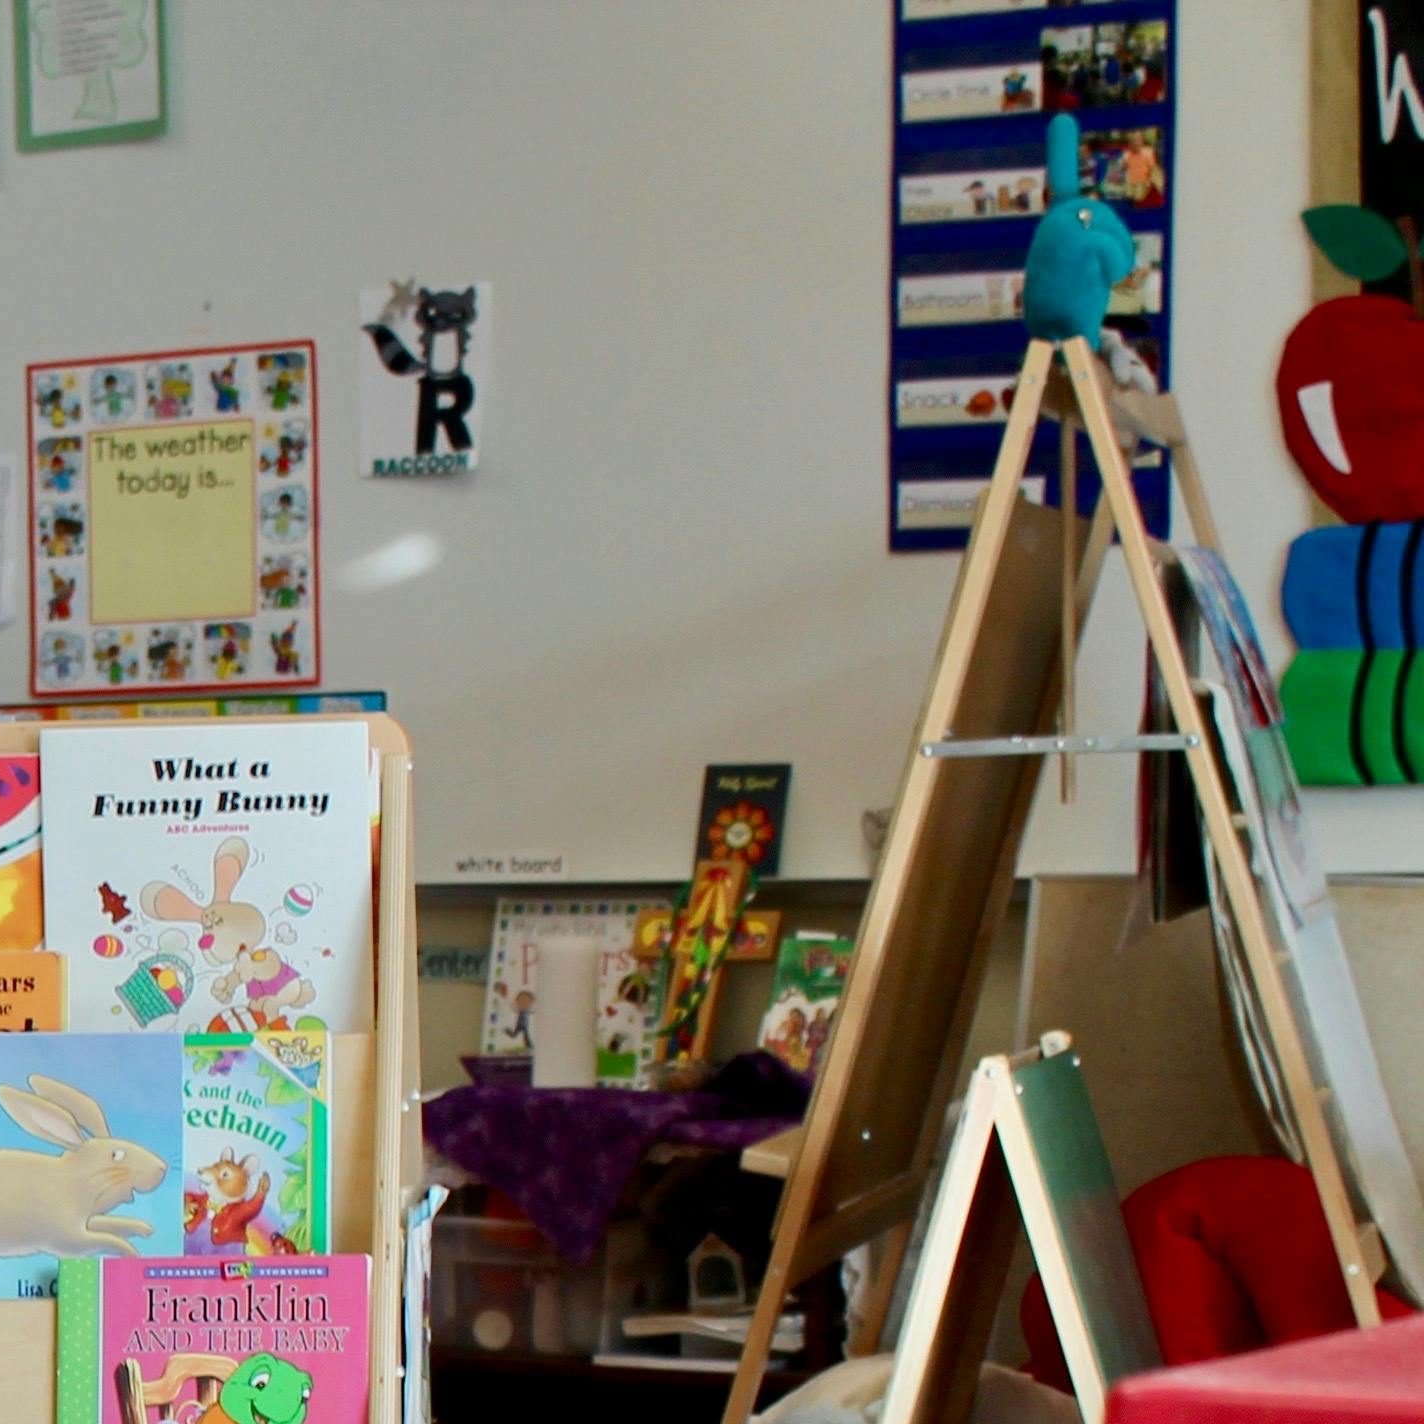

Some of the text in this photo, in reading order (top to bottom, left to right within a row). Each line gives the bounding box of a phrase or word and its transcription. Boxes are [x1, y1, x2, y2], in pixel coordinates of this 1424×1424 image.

[902, 391, 961, 408] Snack
[415, 376, 475, 455] R
[93, 430, 251, 465] The weather
[372, 453, 470, 478] RACCOON
[116, 465, 189, 500] today
[152, 756, 273, 784] What a
[92, 789, 331, 821] Funny Bunny
[166, 821, 251, 836] ABC Adventures
[455, 855, 564, 874] white board
[199, 1084, 264, 1110] and the
[184, 1103, 288, 1152] echaun
[159, 1267, 217, 1278] FRANKLIN
[258, 1267, 325, 1277] STORYBOOK
[17, 1278, 44, 1299] Lisa
[144, 1282, 333, 1325] Franklin
[125, 1326, 350, 1353] AND THE BABY
